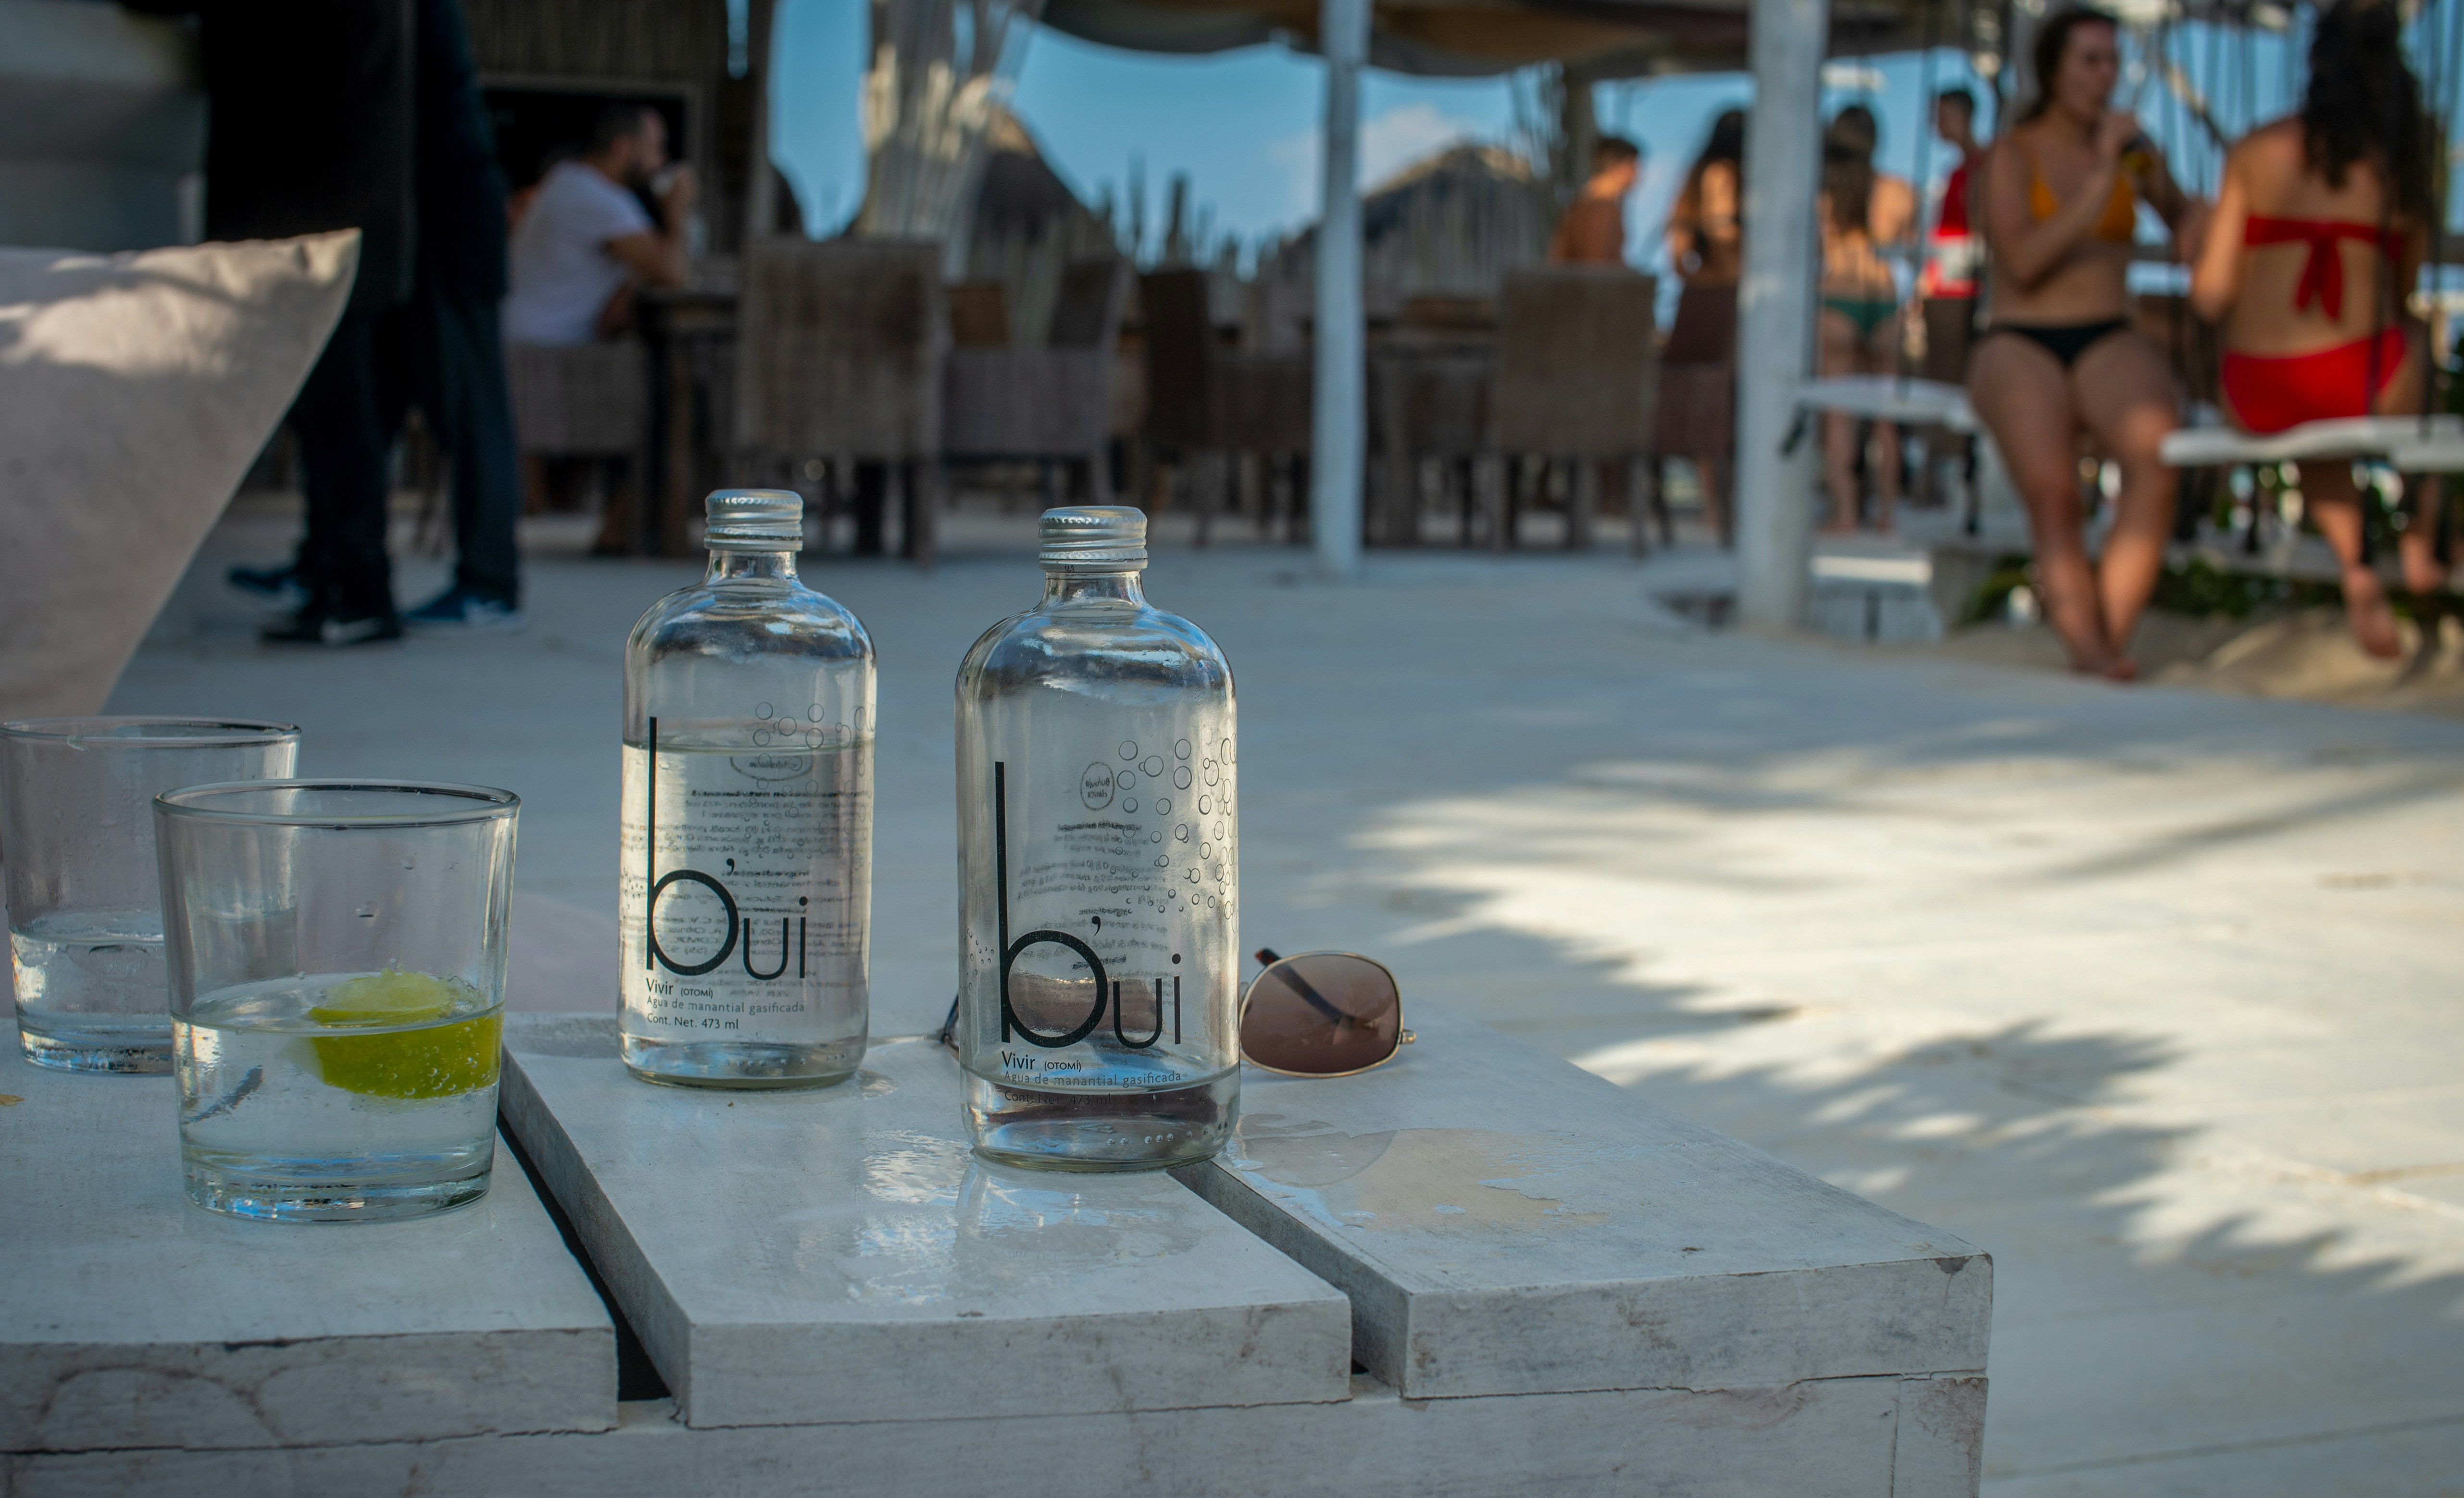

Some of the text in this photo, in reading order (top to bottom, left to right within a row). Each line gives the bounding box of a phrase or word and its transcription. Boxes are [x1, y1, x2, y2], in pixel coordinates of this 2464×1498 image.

[646, 717, 808, 980] b'ui
[995, 761, 1181, 1049] b'ui
[646, 978, 674, 995] Vivir
[681, 987, 713, 999] (OTOMÍ)
[647, 996, 804, 1016] Agua de manantial gasificada
[647, 1013, 738, 1029] Cont. Net. 473 ml
[1001, 1051, 1081, 1072] Vivir (OTOMÍ)
[1004, 1070, 1181, 1088] Agua de manantial gasificada
[1004, 1090, 1034, 1103] Cont.
[1070, 1095, 1090, 1105] 473
[1096, 1093, 1111, 1105] ml
